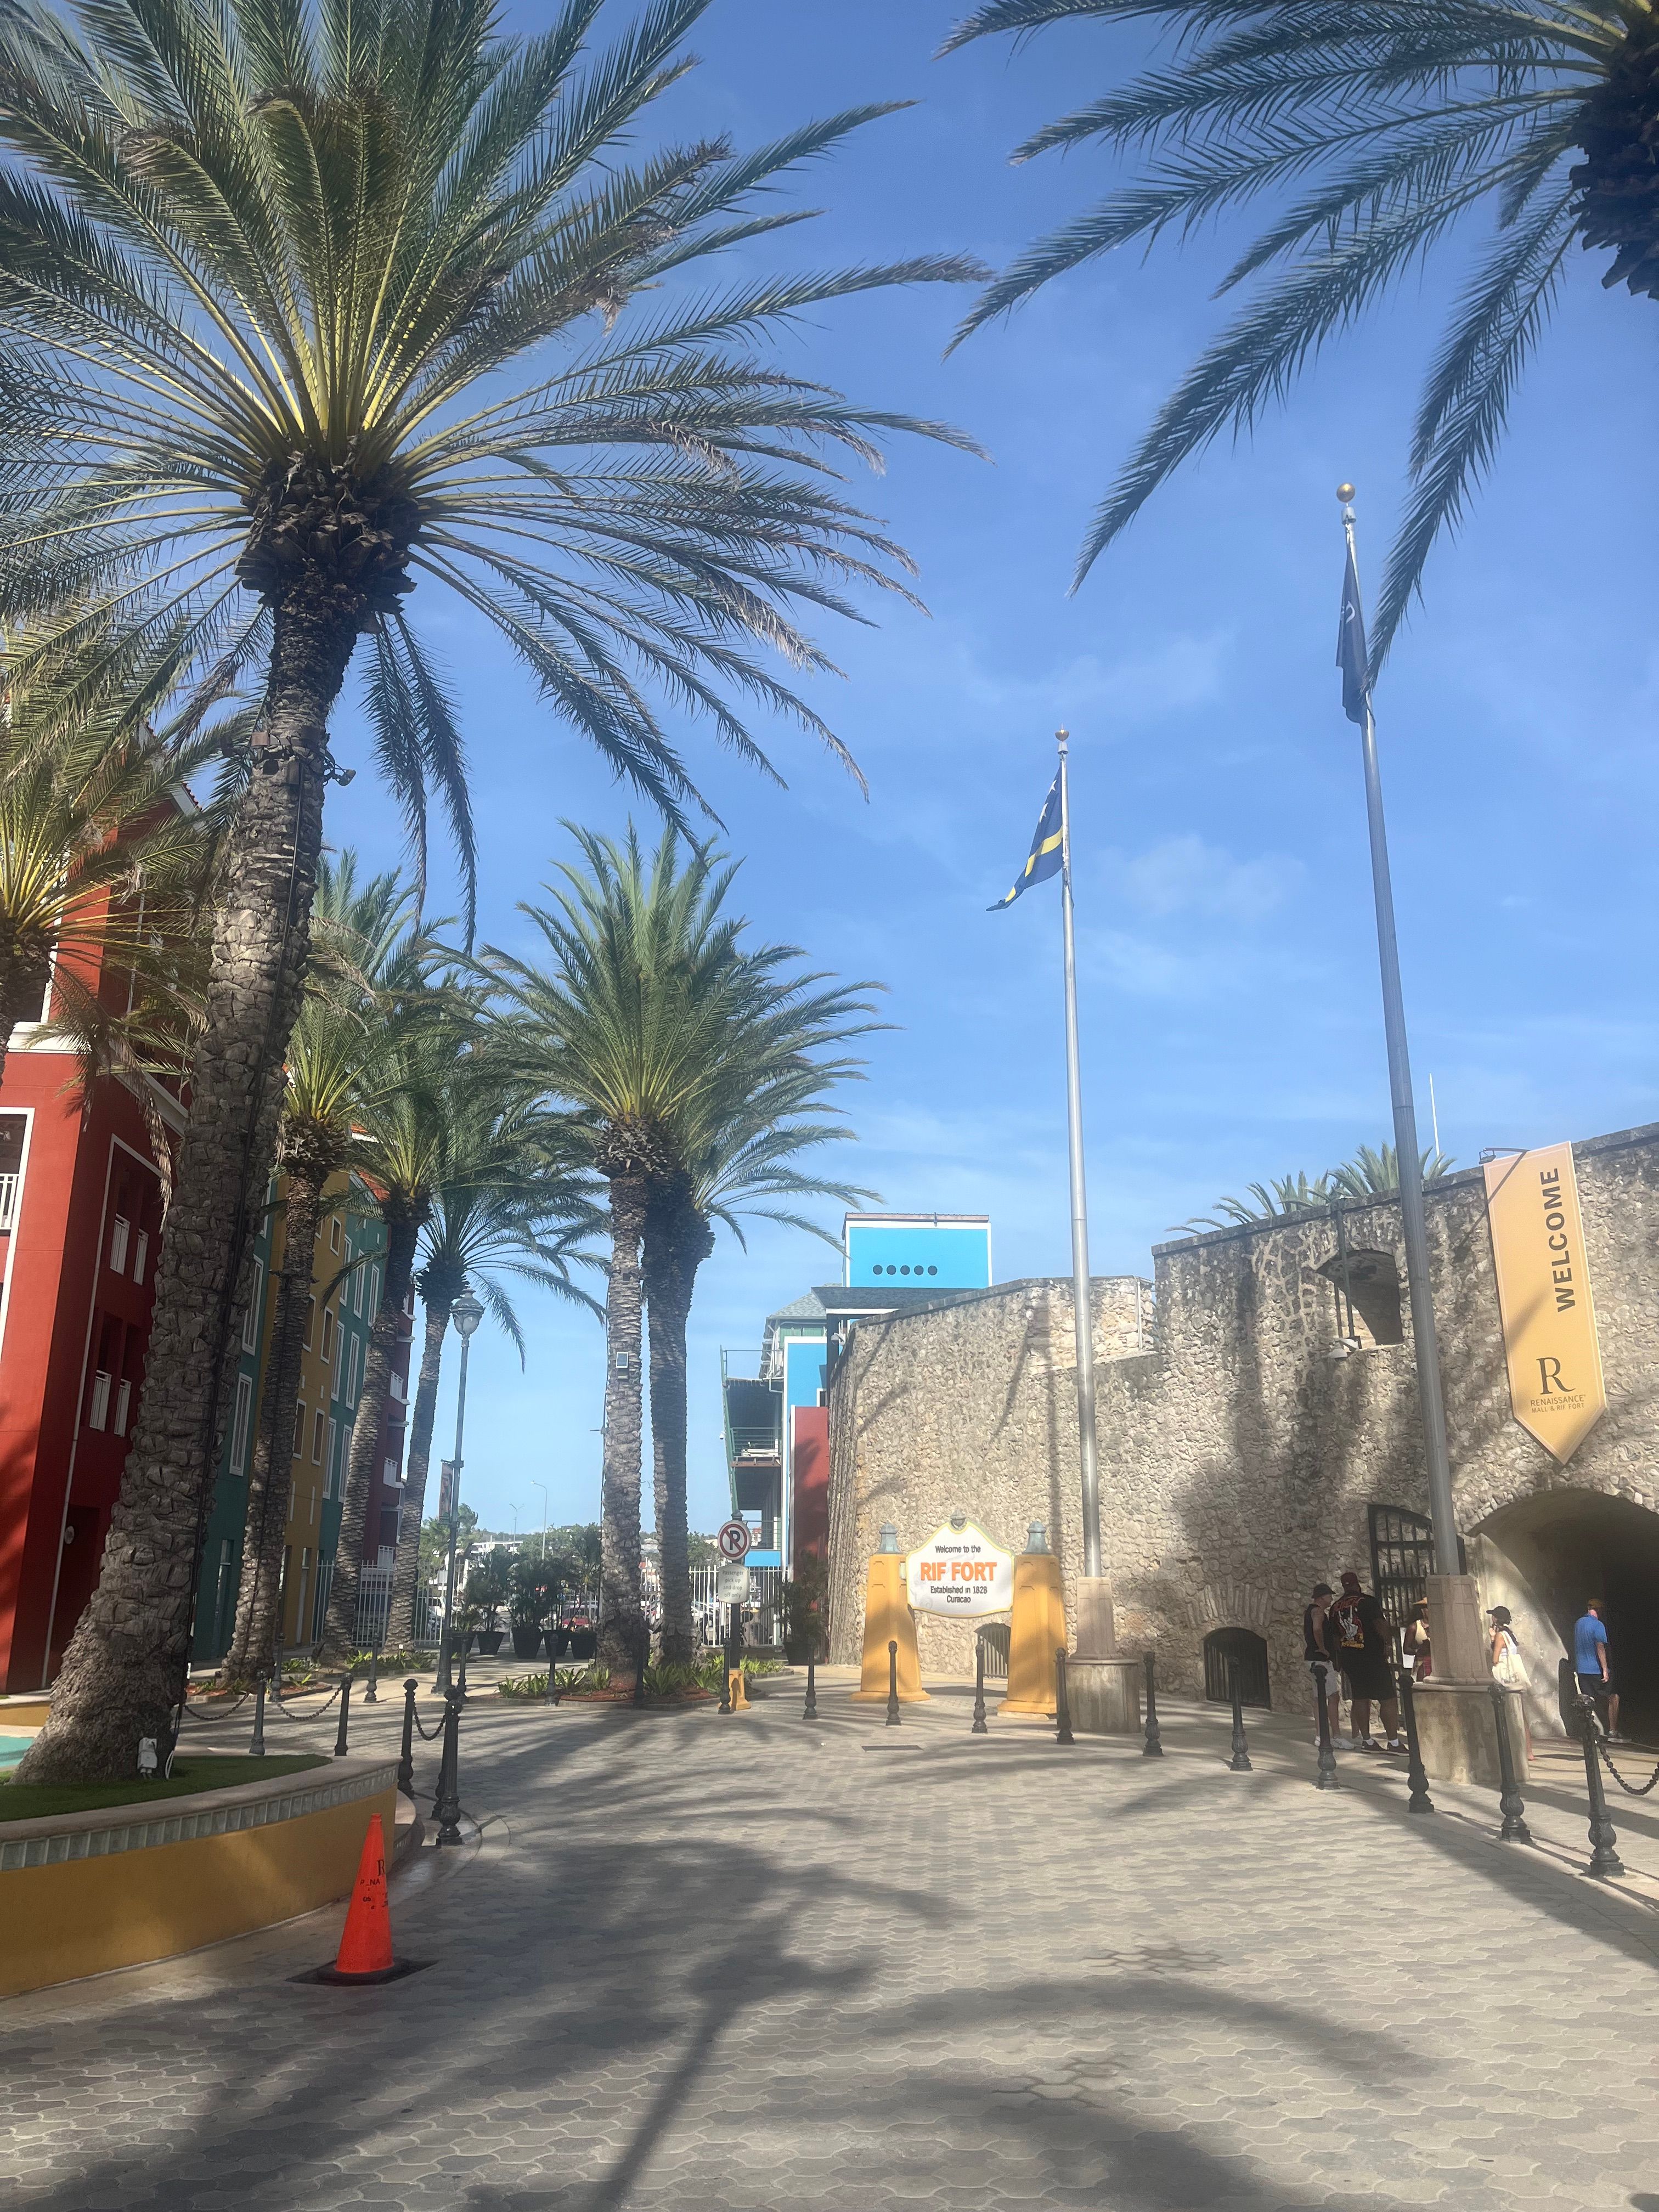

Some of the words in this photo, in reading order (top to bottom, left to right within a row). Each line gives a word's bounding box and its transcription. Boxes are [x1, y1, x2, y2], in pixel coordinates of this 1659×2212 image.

[1540, 1168, 1576, 1312] WELCOME
[1536, 1357, 1576, 1395] R
[971, 1545, 981, 1553] the
[921, 1562, 946, 1581] RIF
[951, 1561, 997, 1581] FORT
